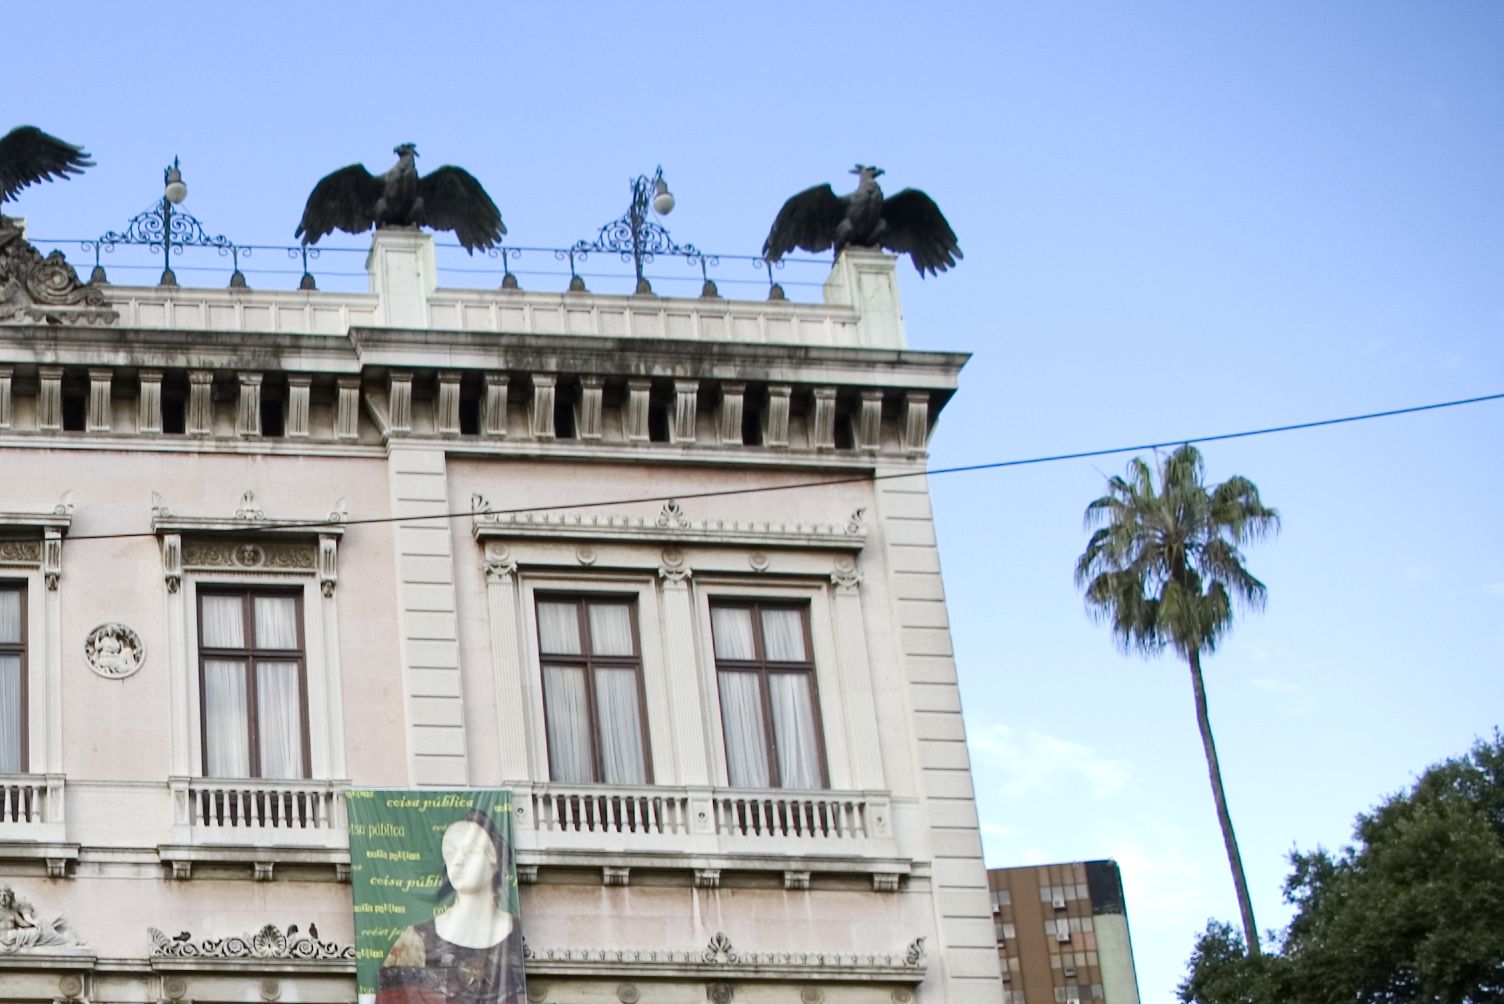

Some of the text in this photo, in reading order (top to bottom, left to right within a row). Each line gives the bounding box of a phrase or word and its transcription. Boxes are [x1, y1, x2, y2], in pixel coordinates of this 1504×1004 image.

[386, 794, 474, 813] coisa pública
[368, 822, 405, 840] pública
[370, 874, 403, 887] coisa
